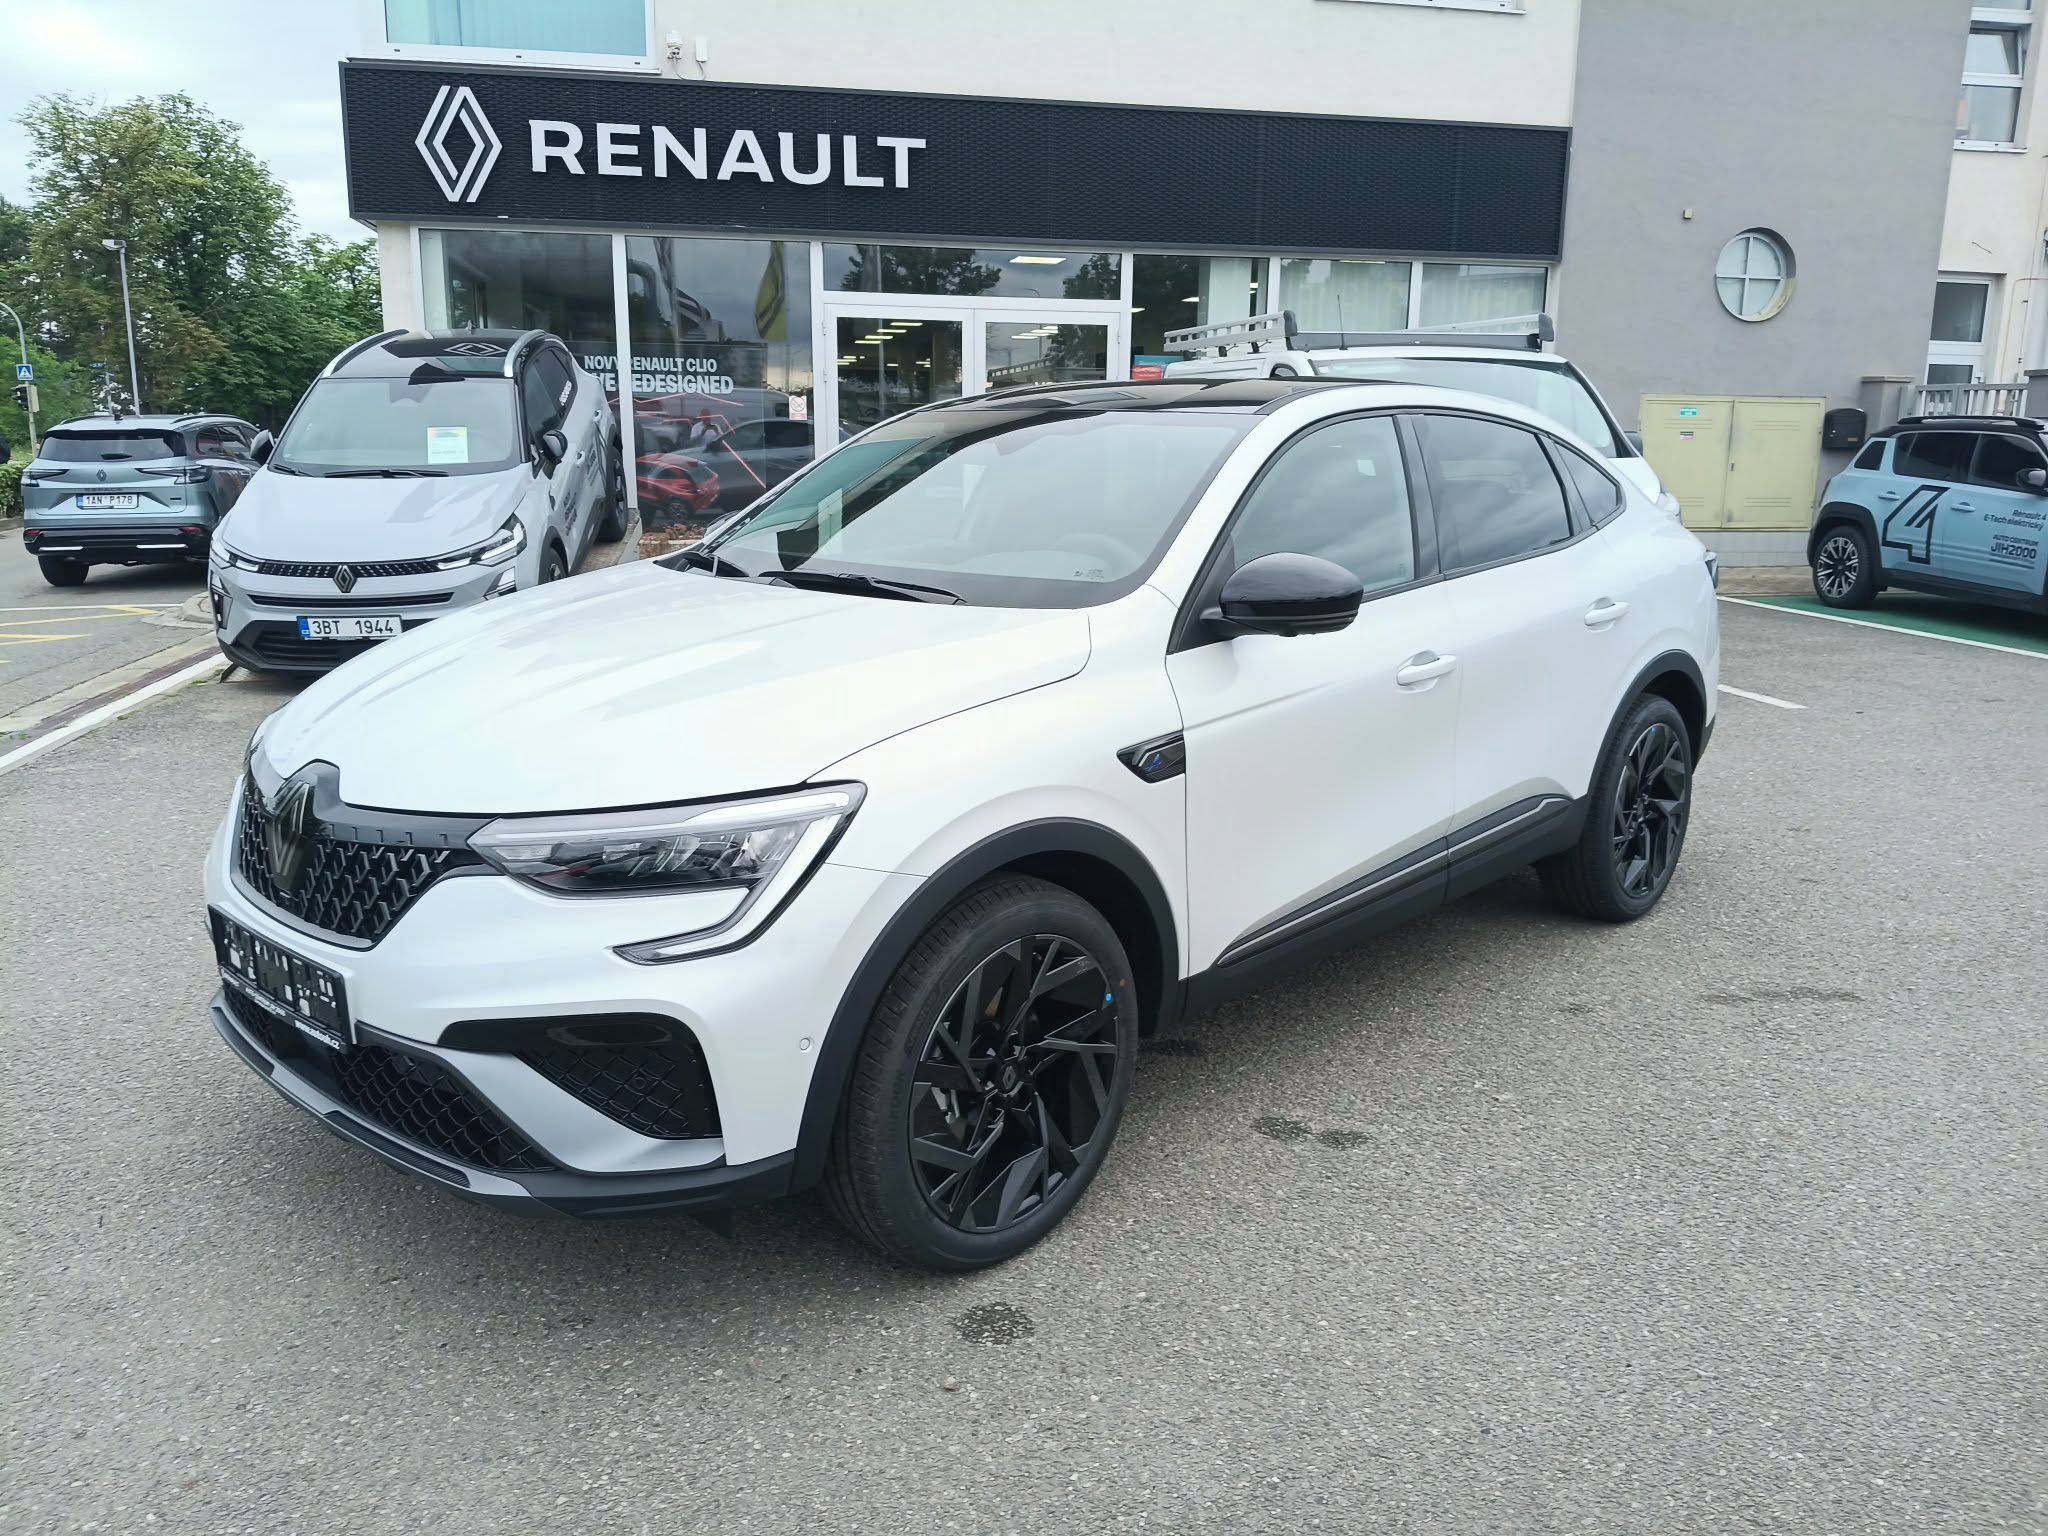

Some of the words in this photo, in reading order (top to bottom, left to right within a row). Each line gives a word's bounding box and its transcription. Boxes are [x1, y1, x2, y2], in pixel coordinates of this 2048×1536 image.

[528, 119, 927, 189] RENAULT
[631, 356, 684, 372] ENAULT
[686, 358, 718, 373] CLIO
[631, 374, 734, 394] EDESIGNED
[86, 495, 103, 505] 1AN
[109, 495, 133, 505] P178
[1990, 543, 2037, 559] JIH2000
[312, 620, 340, 634] 3BT
[355, 619, 394, 634] 1944
